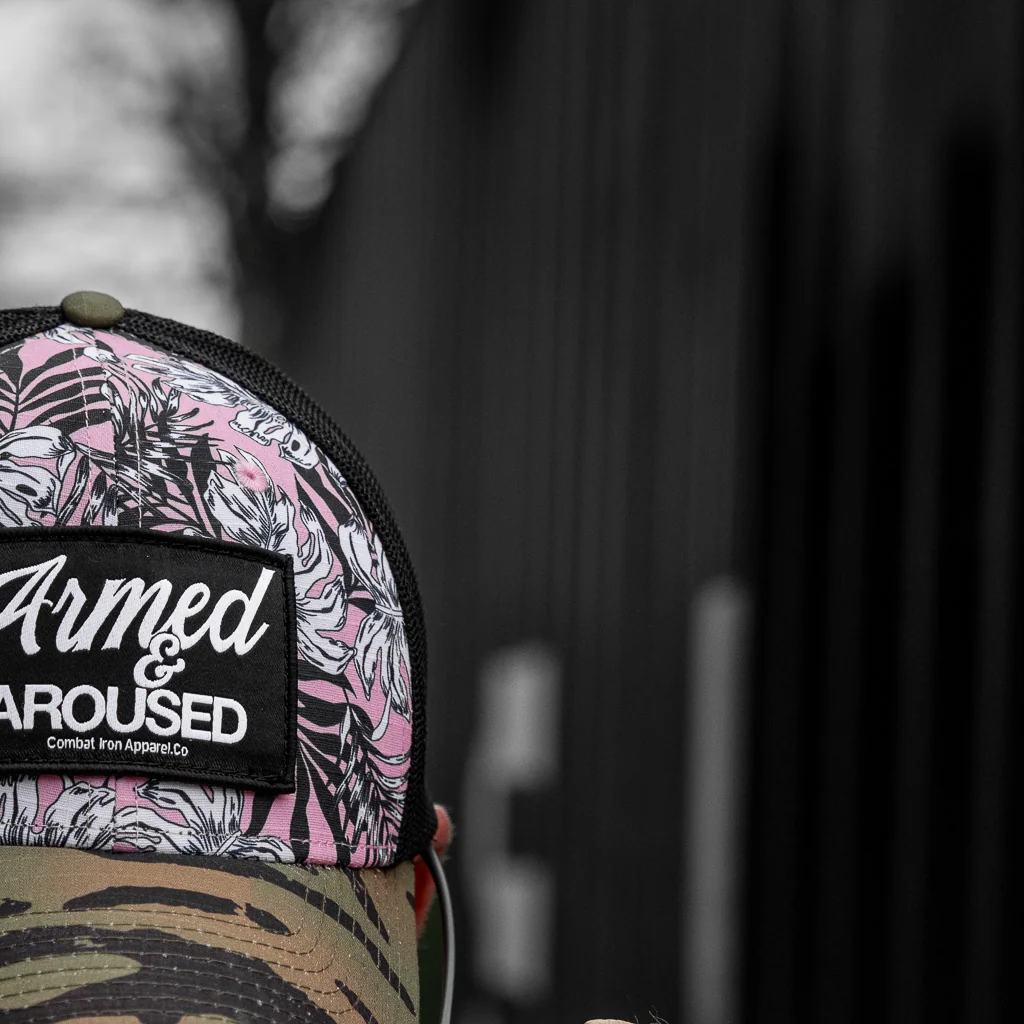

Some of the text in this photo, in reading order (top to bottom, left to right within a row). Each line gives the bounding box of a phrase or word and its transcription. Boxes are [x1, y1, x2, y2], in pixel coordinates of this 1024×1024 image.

[133, 631, 186, 689] &
[46, 736, 189, 757] Combat Iron Apparel.Co
